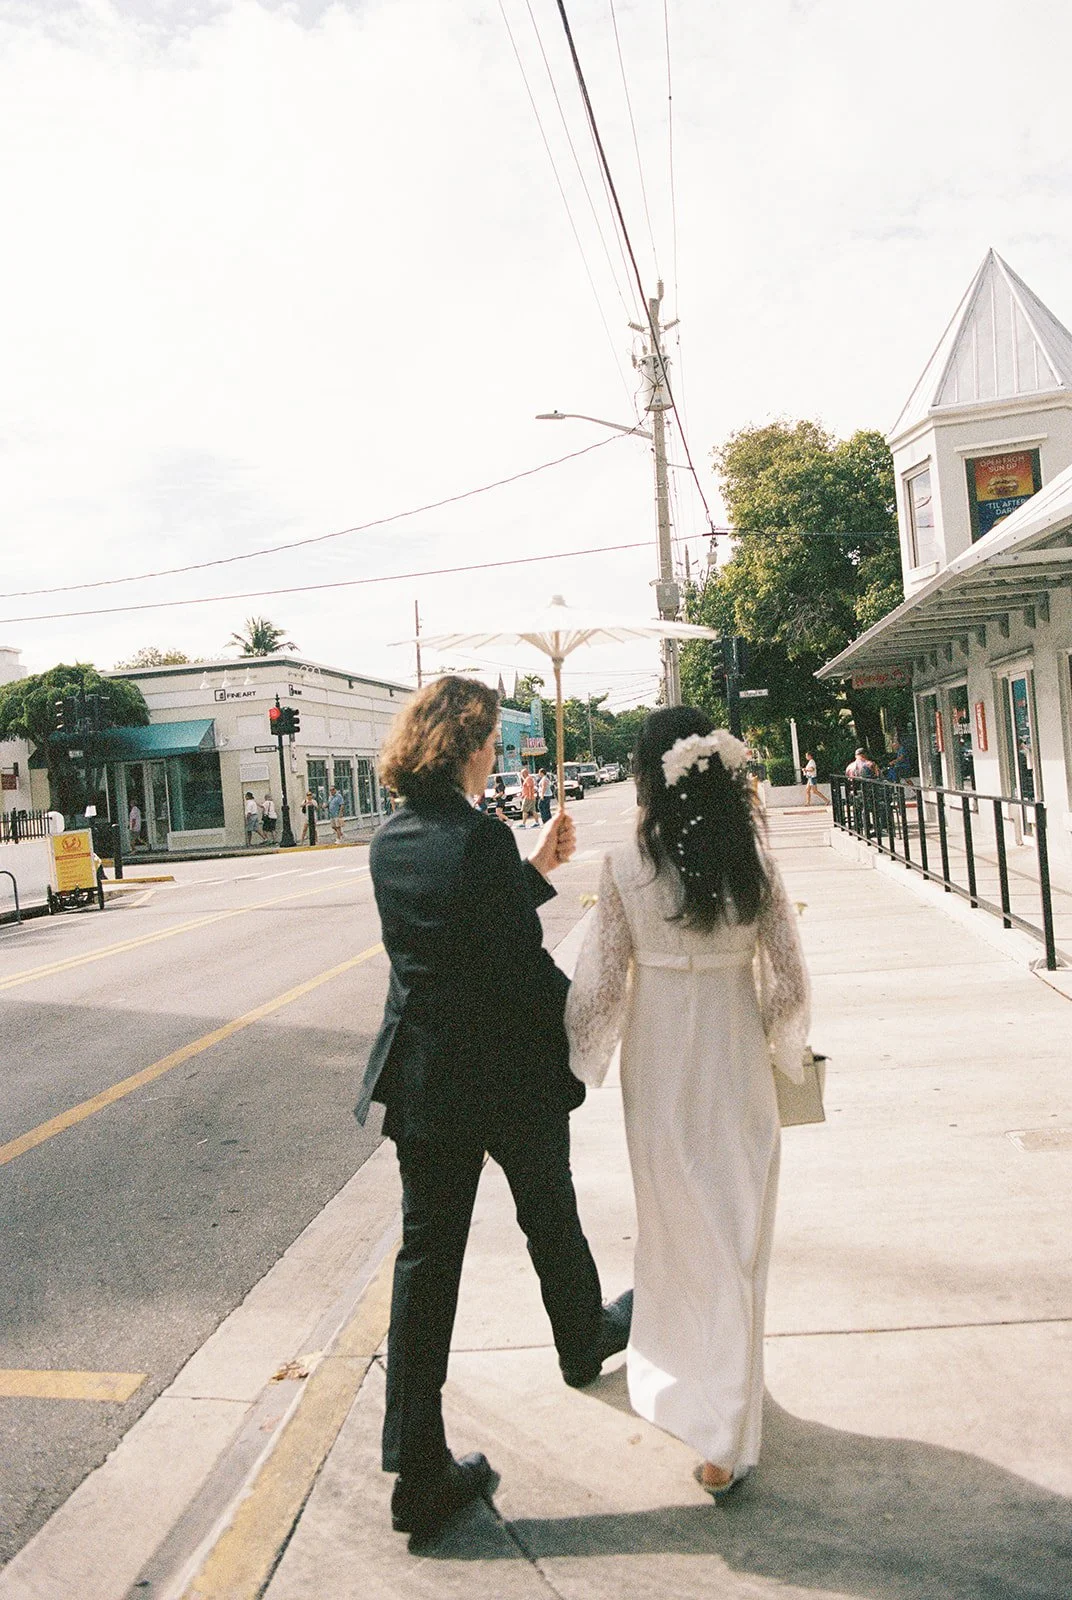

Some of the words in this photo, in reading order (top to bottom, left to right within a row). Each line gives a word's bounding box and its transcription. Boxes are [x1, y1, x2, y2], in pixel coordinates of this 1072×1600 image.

[980, 458, 1002, 467] OPEN
[988, 464, 1005, 472] SUN
[1006, 462, 1017, 470] UP
